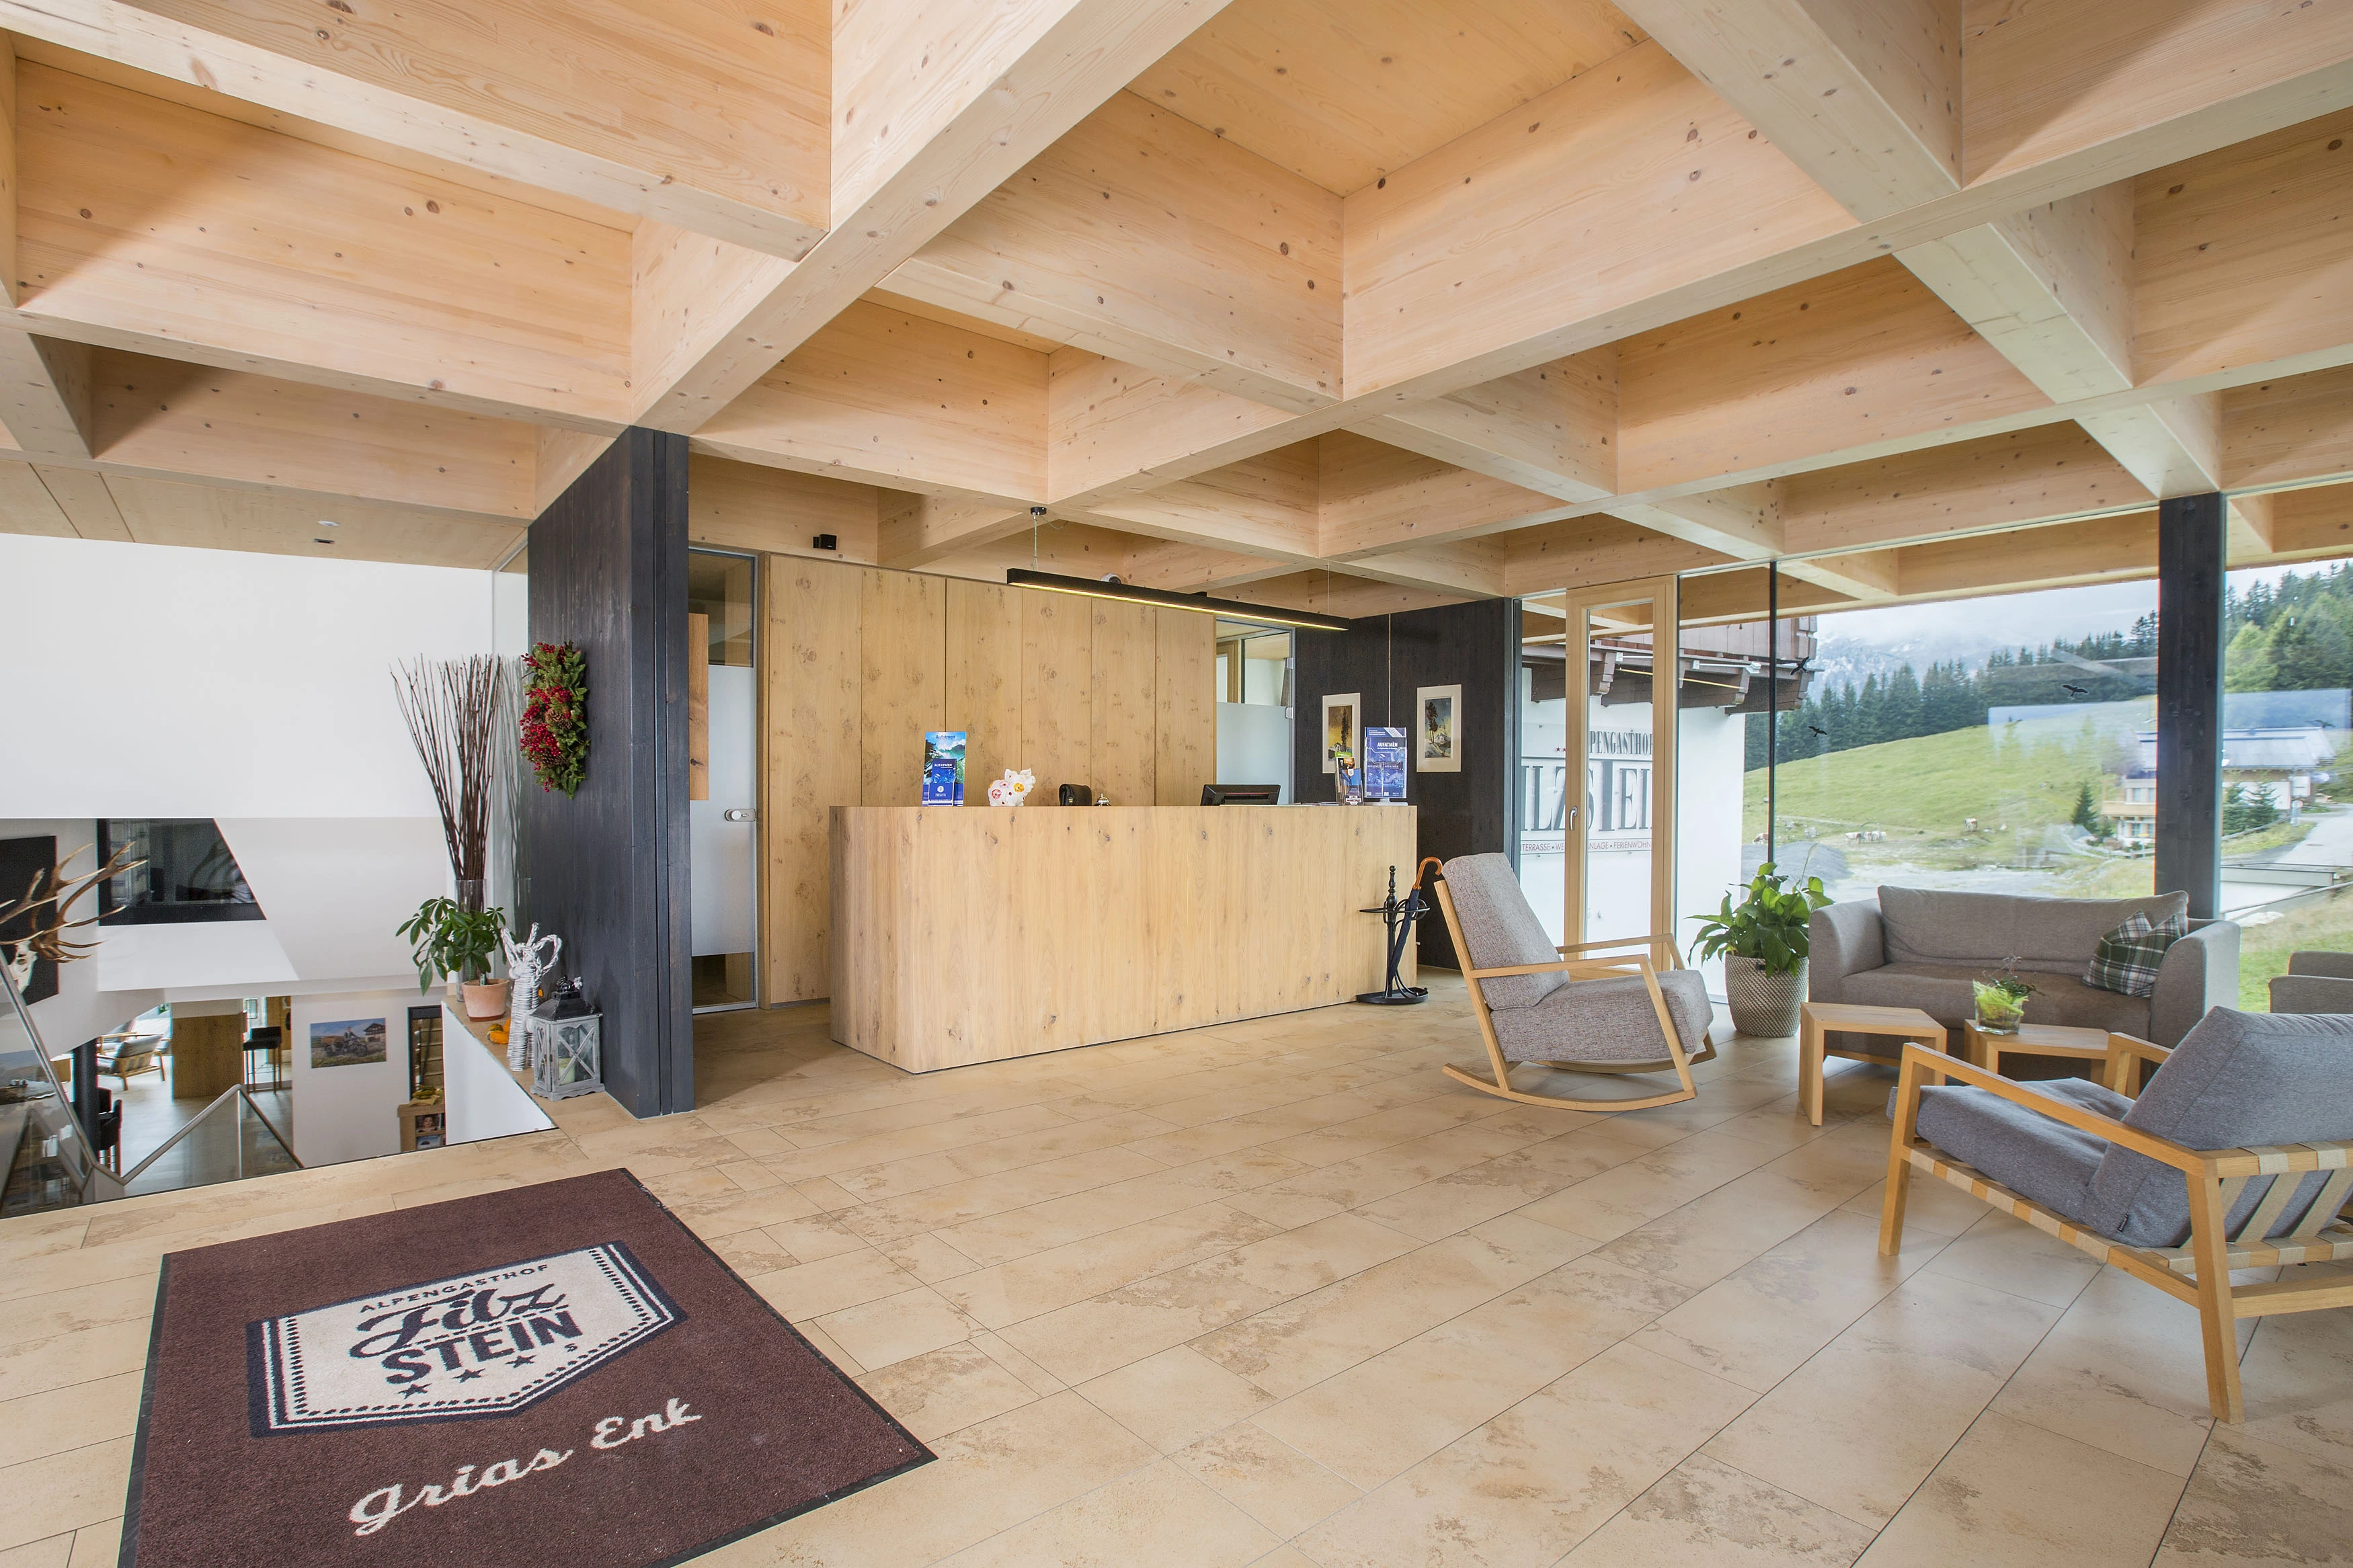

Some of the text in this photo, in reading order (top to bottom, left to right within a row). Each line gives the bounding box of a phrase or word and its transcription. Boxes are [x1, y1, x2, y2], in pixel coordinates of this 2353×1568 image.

[1521, 843, 1550, 852] TERRASSE
[360, 1264, 548, 1313] ALPENGASTHOF
[349, 1283, 566, 1358] Filz
[381, 1311, 583, 1385] STEIN
[590, 1397, 703, 1450] Enk
